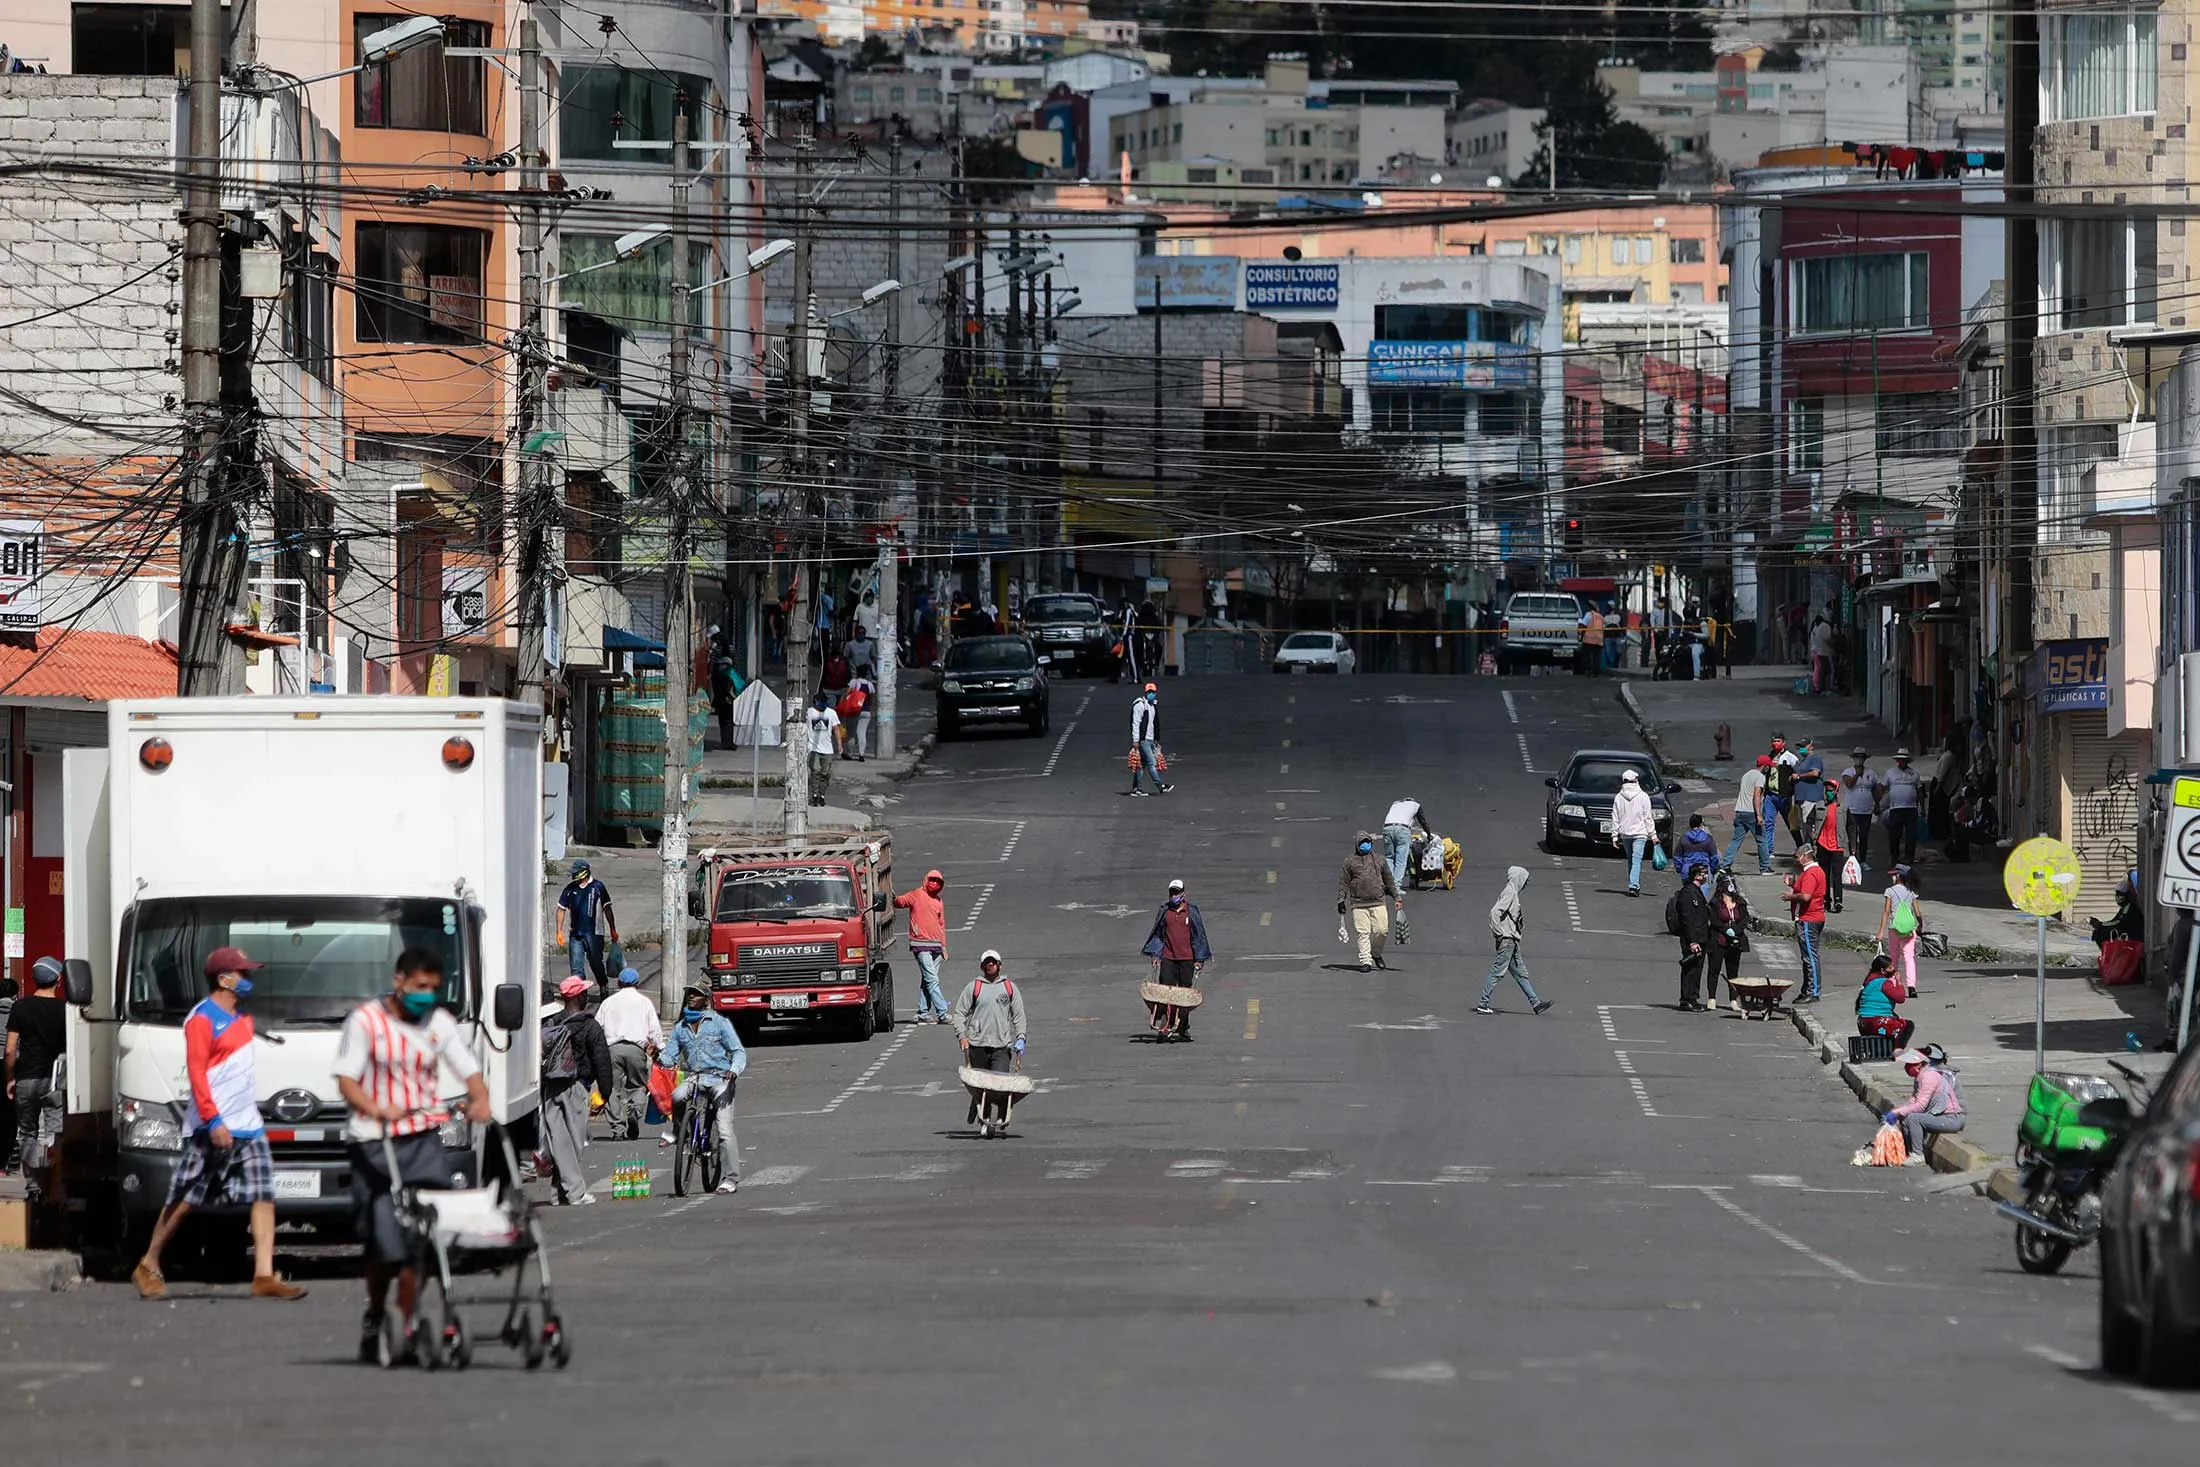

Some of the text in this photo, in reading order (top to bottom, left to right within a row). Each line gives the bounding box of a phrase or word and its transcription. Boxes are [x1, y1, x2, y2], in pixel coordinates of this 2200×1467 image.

[1247, 268, 1337, 282] CONSULTORIO
[1247, 285, 1337, 302] OBSTÉTRICO
[1374, 344, 1451, 356] CLINICA
[1520, 629, 1568, 639] TOYOTA
[2091, 692, 2096, 701] Y
[753, 946, 821, 956] DAIHATSU
